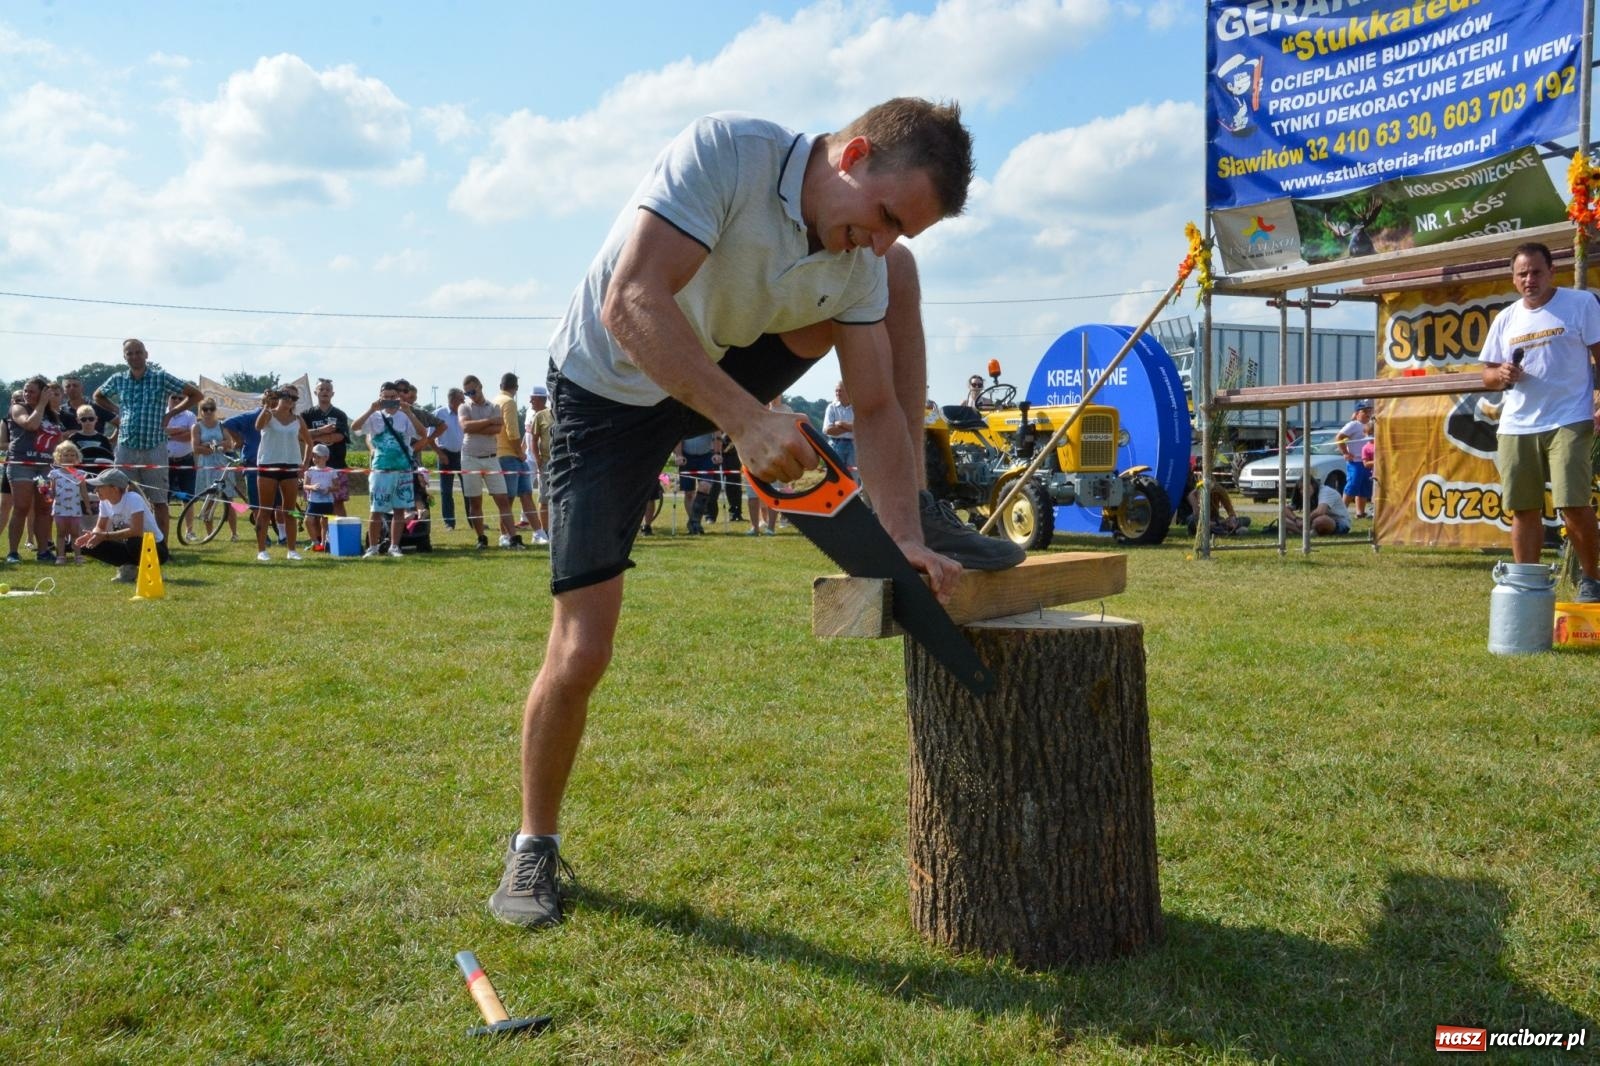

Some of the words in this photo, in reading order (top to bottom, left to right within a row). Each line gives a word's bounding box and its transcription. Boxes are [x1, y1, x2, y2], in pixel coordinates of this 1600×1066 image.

[1216, 0, 1368, 41] GERA
[1281, 0, 1480, 61] “Stukkateu
[1269, 76, 1377, 115] PRODUKCJA
[1382, 33, 1508, 88] SZTUKATERII
[1271, 52, 1376, 93] OCIEPLANIE
[1382, 12, 1493, 64] BUDYNKÓW
[1271, 112, 1320, 136] TYNKI
[1325, 76, 1457, 125] DEKORACYJNE
[1461, 60, 1506, 89] ZEW.
[1511, 55, 1519, 72] I
[1524, 34, 1575, 68] WEW.
[1217, 145, 1304, 178] Sławików
[1306, 136, 1329, 161] 32
[1333, 128, 1370, 155] 410
[1376, 119, 1401, 146] 63
[1406, 112, 1437, 139] 30,
[1443, 97, 1481, 130] 603
[1488, 82, 1527, 117] 703
[1534, 65, 1577, 102] 192
[1280, 129, 1497, 191] www.sztukateria-fitzon.pl
[1415, 213, 1442, 233] NR.
[1444, 209, 1456, 227] 1
[1390, 305, 1501, 361] STRO
